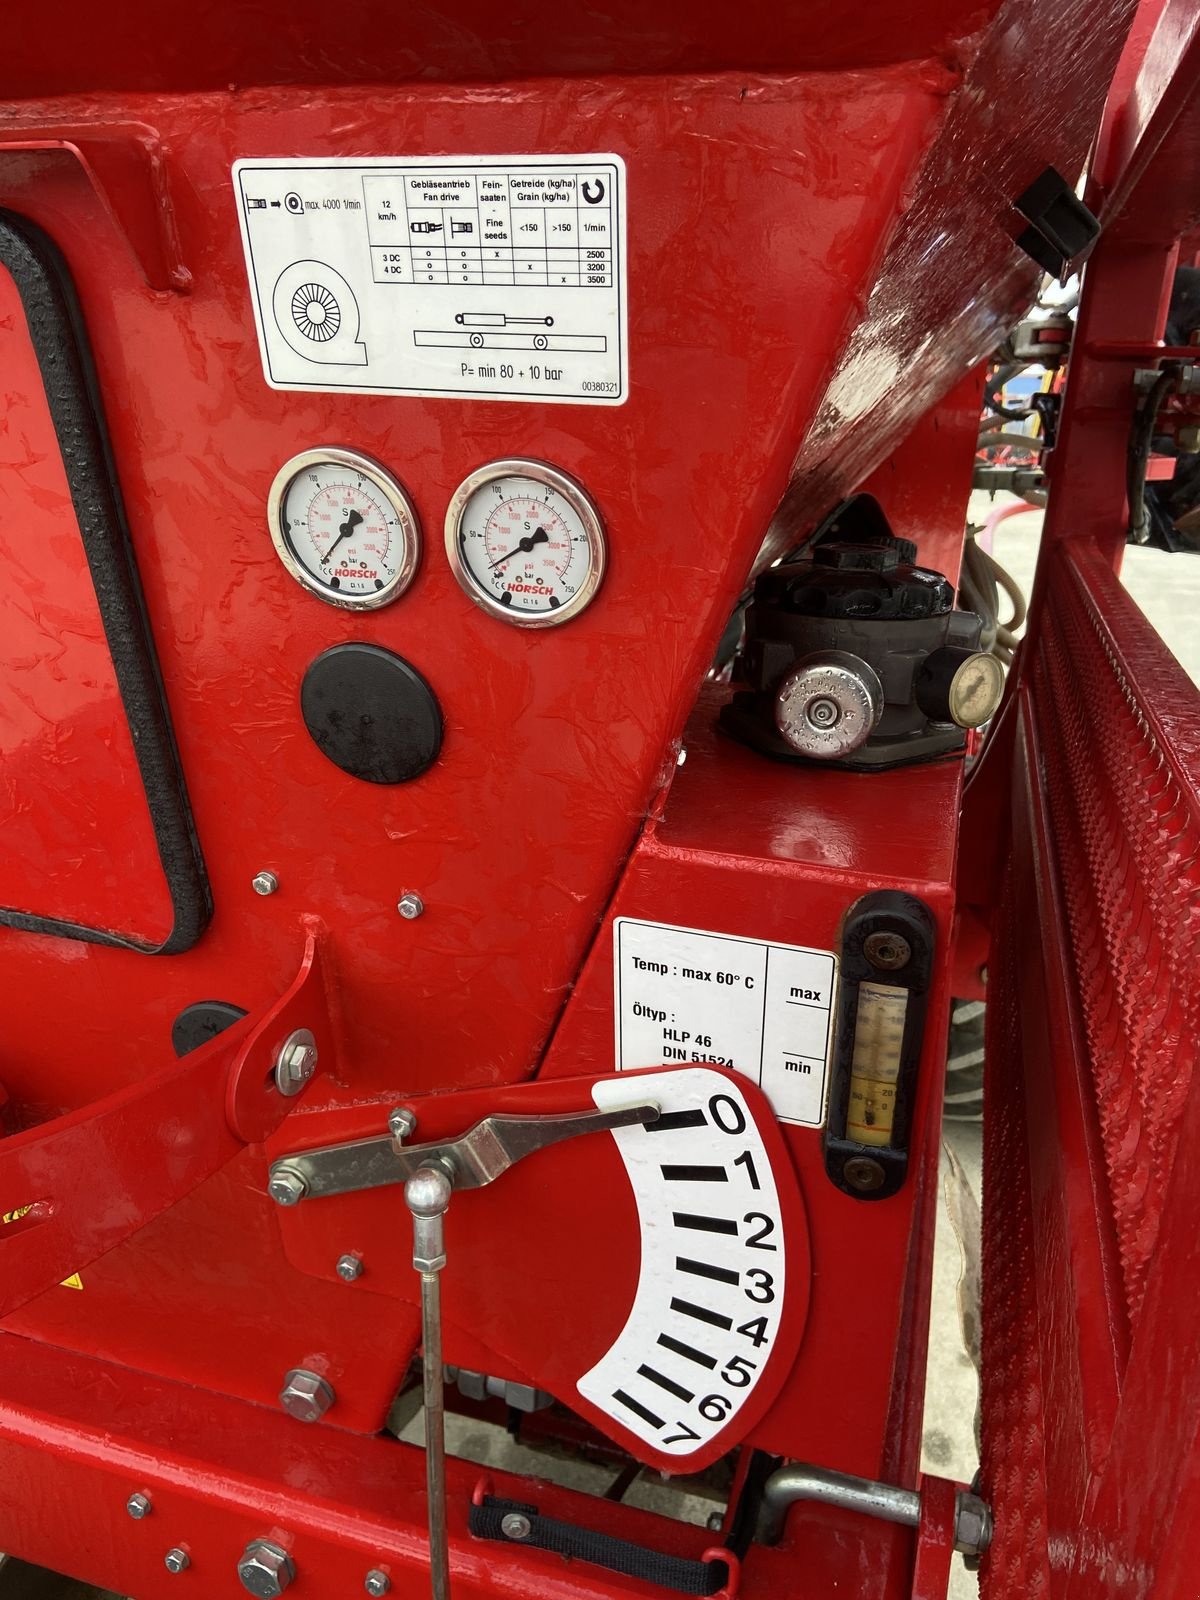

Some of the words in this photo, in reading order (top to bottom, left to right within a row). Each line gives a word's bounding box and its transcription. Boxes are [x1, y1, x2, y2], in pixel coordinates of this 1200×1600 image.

[411, 180, 470, 188] Gebläseantrieb
[510, 180, 545, 188] Getreide
[548, 179, 576, 189] (kg/ha)
[542, 192, 570, 202] (kg/ha)
[305, 202, 320, 210] max
[323, 200, 340, 209] 4000
[344, 200, 361, 210] 1/min
[552, 224, 571, 232] >150
[584, 224, 606, 232] 1/min
[461, 363, 475, 377] P=
[478, 366, 495, 378] min
[500, 365, 514, 378] 80
[529, 366, 540, 379] 10
[545, 367, 562, 380] bar
[582, 382, 617, 392] 00380321
[492, 486, 501, 494] 100
[342, 508, 348, 516] S
[524, 522, 530, 530] S
[335, 569, 377, 578] HORSCH
[507, 583, 553, 595] HORSCH
[632, 956, 668, 976] Temp
[673, 966, 677, 976] :
[682, 967, 712, 982] max
[716, 972, 740, 986] 60°
[744, 976, 754, 989] C
[790, 986, 821, 1001] max
[633, 1002, 666, 1022] Öltyp
[671, 1013, 675, 1022] :
[663, 1028, 690, 1043] HLP
[695, 1034, 712, 1047] 46
[663, 1046, 687, 1061] DIN
[691, 1051, 734, 1069] 51524
[785, 1060, 811, 1074] min
[708, 1094, 747, 1135] 0
[733, 1150, 761, 1190] 1
[744, 1211, 777, 1251] 2
[744, 1268, 775, 1304] 3
[736, 1316, 769, 1348] 4
[720, 1355, 757, 1388] 5
[698, 1394, 732, 1422] 6
[662, 1421, 702, 1445] 7
